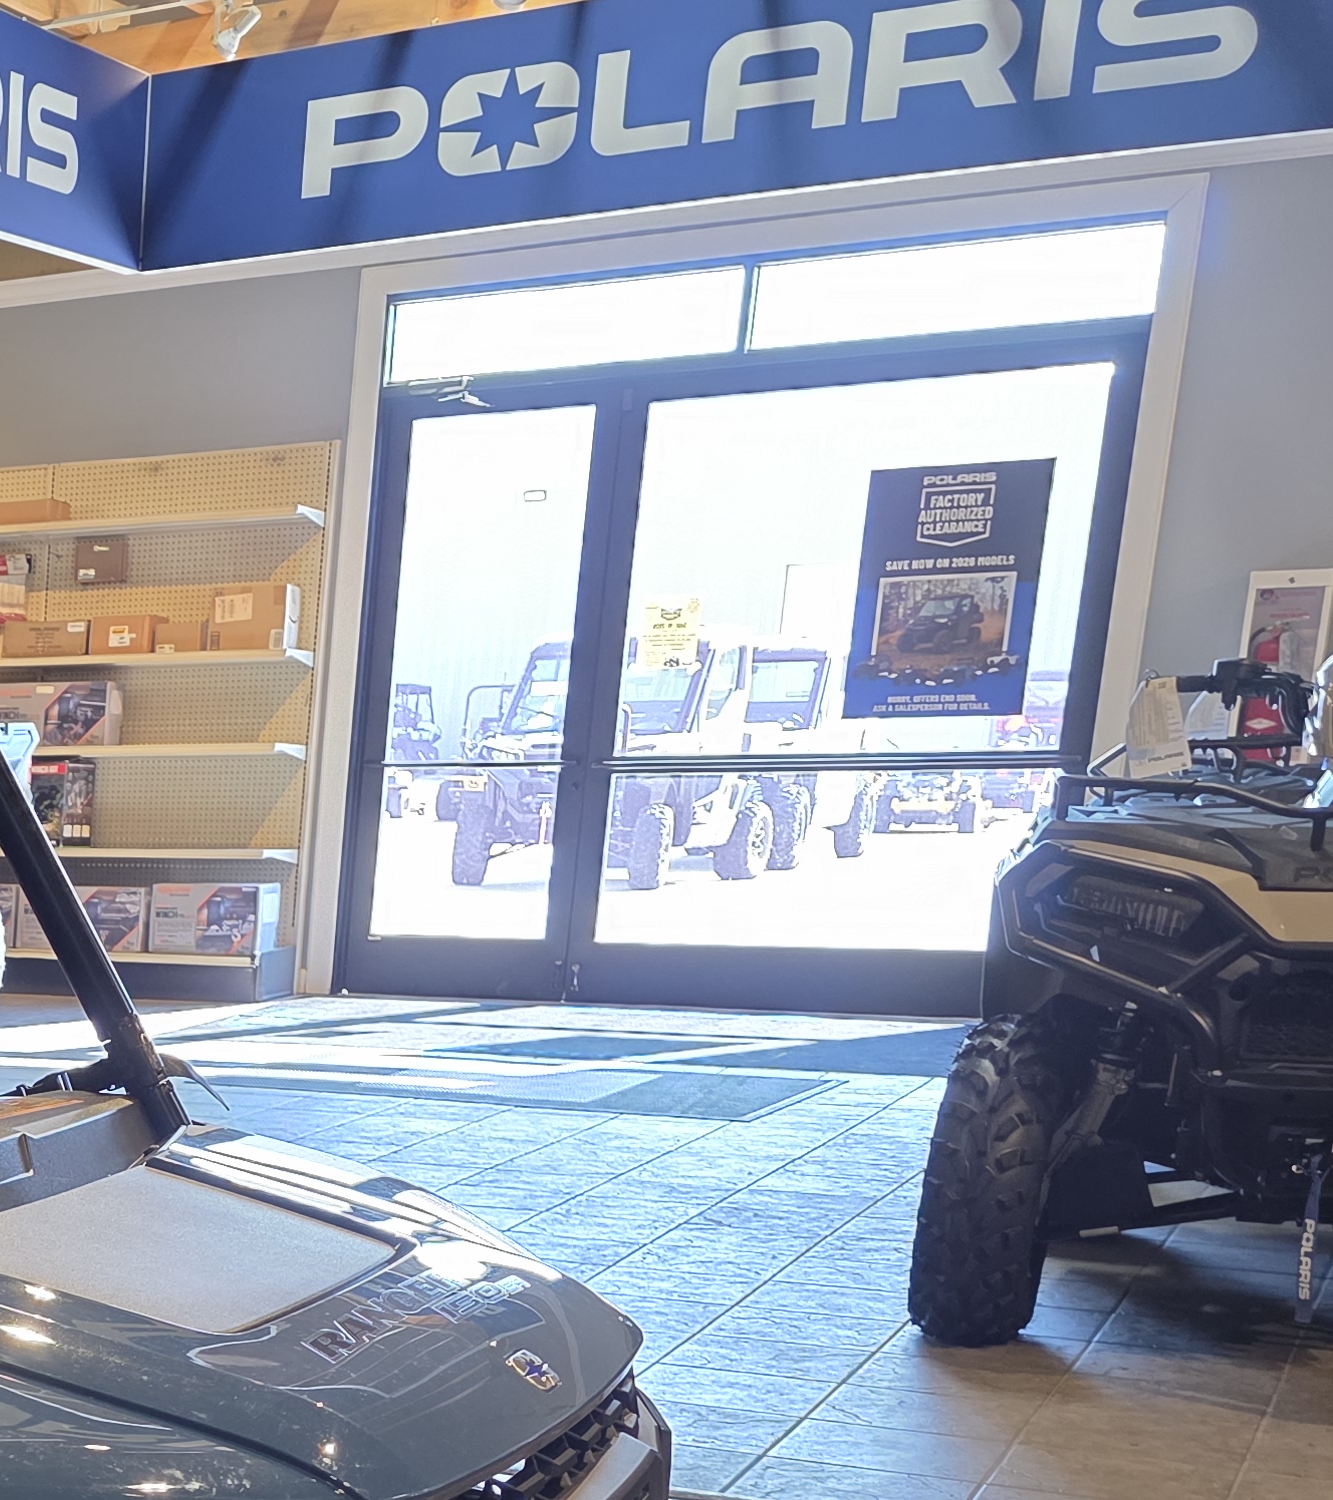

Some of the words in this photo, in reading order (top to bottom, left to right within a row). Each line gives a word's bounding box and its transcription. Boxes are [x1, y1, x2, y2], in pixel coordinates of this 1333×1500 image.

[299, 0, 1259, 199] POLARIS
[923, 472, 997, 486] POLARIS
[930, 493, 985, 508] FACTORY
[918, 506, 993, 523] AUTHORIZED
[923, 521, 985, 535] CLEARANCE
[885, 560, 909, 571] SAVE
[911, 559, 934, 570] NOW
[936, 558, 950, 568] ON
[977, 555, 1015, 566] MODELS
[1298, 1218, 1316, 1300] POLARIS
